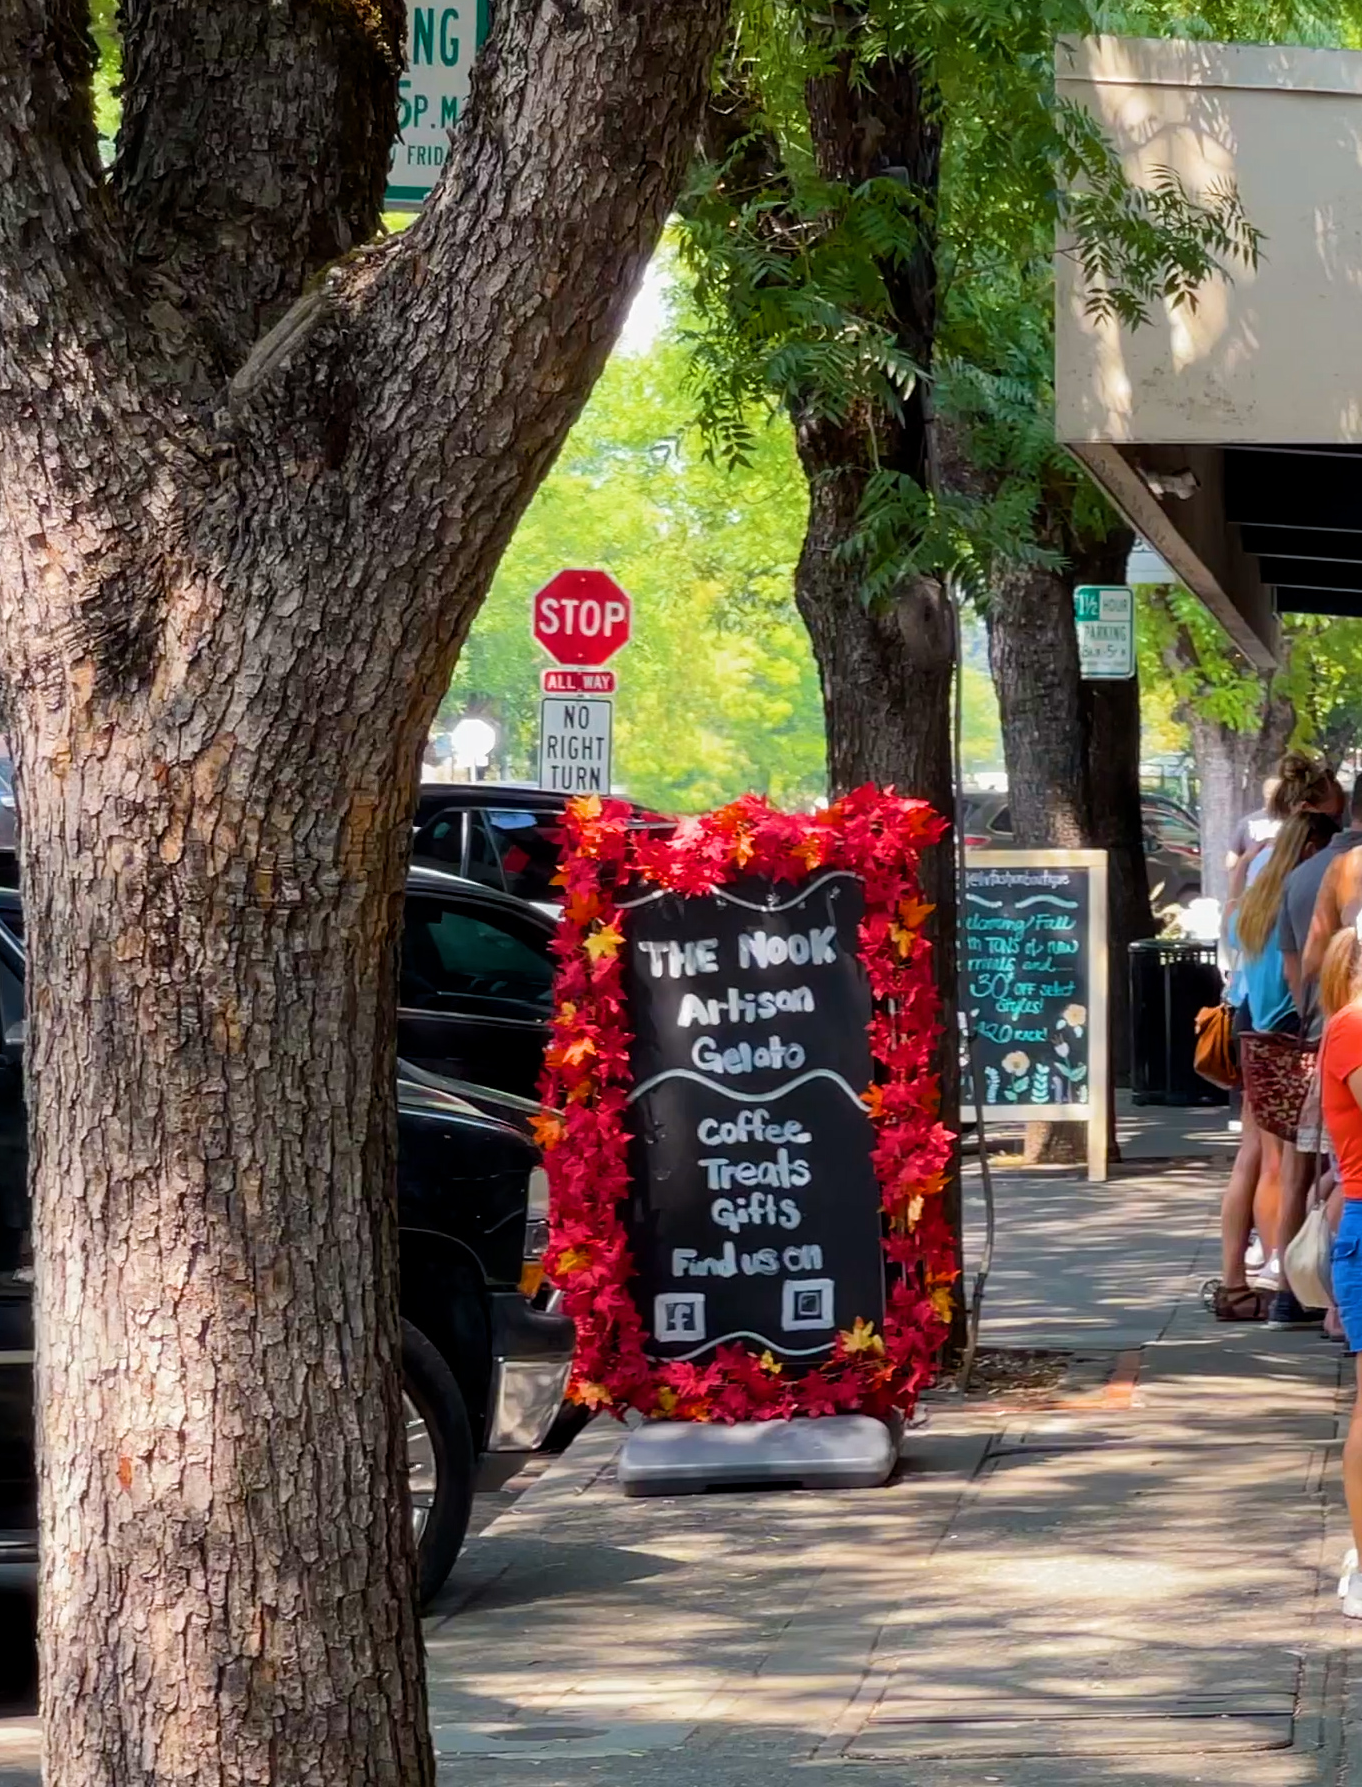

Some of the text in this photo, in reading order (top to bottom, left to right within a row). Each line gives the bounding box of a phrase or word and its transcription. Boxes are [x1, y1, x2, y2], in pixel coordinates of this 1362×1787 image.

[407, 145, 451, 166] FRID
[539, 598, 626, 637] STOP
[547, 674, 611, 690] ALL WAY
[563, 705, 590, 730] NO
[547, 735, 605, 761] RIGHT
[550, 765, 601, 790] TURN
[1035, 913, 1077, 931] Fall
[638, 937, 720, 979] THE
[984, 936, 1020, 954] TONS
[1047, 940, 1079, 955] new
[677, 985, 815, 1028] Artisan
[691, 1035, 806, 1075] Gelato
[697, 1108, 813, 1146] Coffee
[697, 1147, 812, 1190] Treats
[711, 1191, 802, 1233] Gifts
[671, 1240, 823, 1279] Find us on
